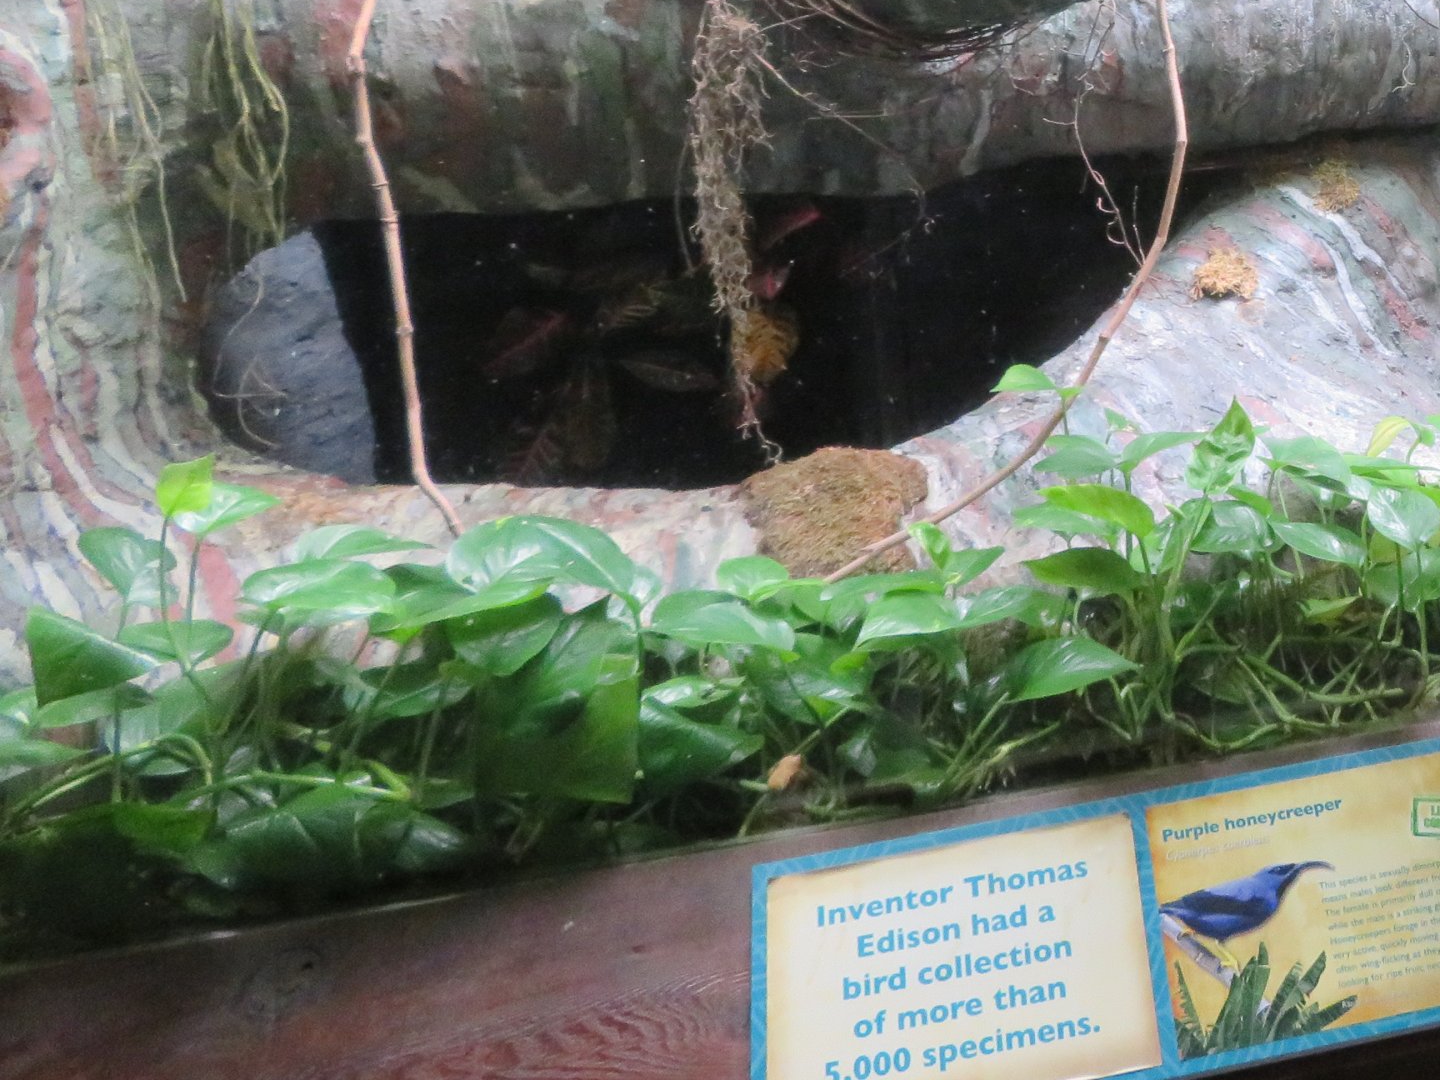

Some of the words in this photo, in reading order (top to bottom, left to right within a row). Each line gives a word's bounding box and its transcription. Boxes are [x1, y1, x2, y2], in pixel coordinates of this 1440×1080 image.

[1162, 822, 1219, 842] Purple
[1224, 799, 1342, 831] honeycreeper
[817, 884, 954, 927] Inventor
[964, 861, 1089, 899] Thomas
[857, 919, 961, 959] Edison
[972, 905, 1027, 938] had
[1038, 905, 1056, 923] a
[842, 967, 906, 1000] bird
[918, 938, 1072, 985] collection
[853, 1010, 887, 1039] of
[898, 997, 983, 1030] more
[994, 982, 1067, 1011] than
[922, 1016, 1100, 1072] specimens.
